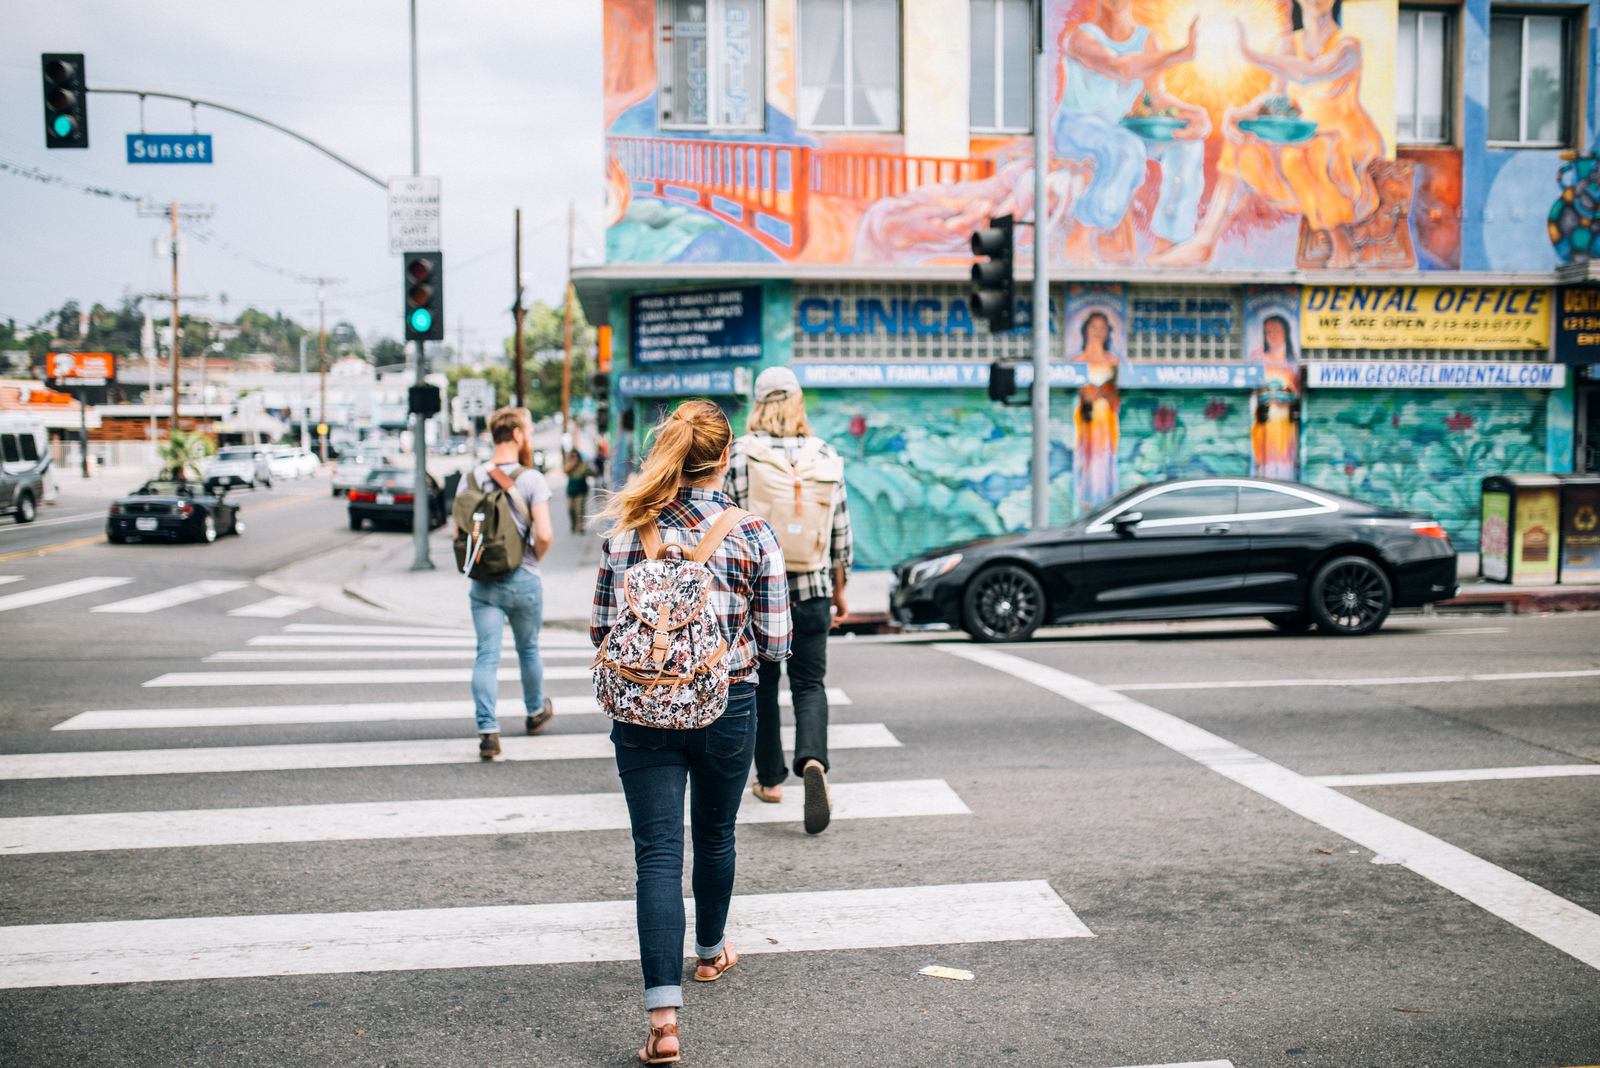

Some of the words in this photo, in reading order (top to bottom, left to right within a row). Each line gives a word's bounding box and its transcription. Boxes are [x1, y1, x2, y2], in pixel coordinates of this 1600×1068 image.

[133, 138, 206, 159] Sunset
[1307, 287, 1419, 312] DENTAL
[1433, 287, 1546, 314] OFFICE
[799, 297, 975, 335] CLINICA
[1319, 317, 1341, 328] WE
[1348, 317, 1377, 328] ARE
[1383, 317, 1427, 328] OPEN
[804, 364, 884, 383] MEDICINA
[885, 364, 958, 383] FAMILIAR
[961, 365, 976, 383] Y
[1156, 366, 1230, 385] VACUNAS
[1320, 364, 1554, 384] WWW.GEORGELIMDENTAL.COM
